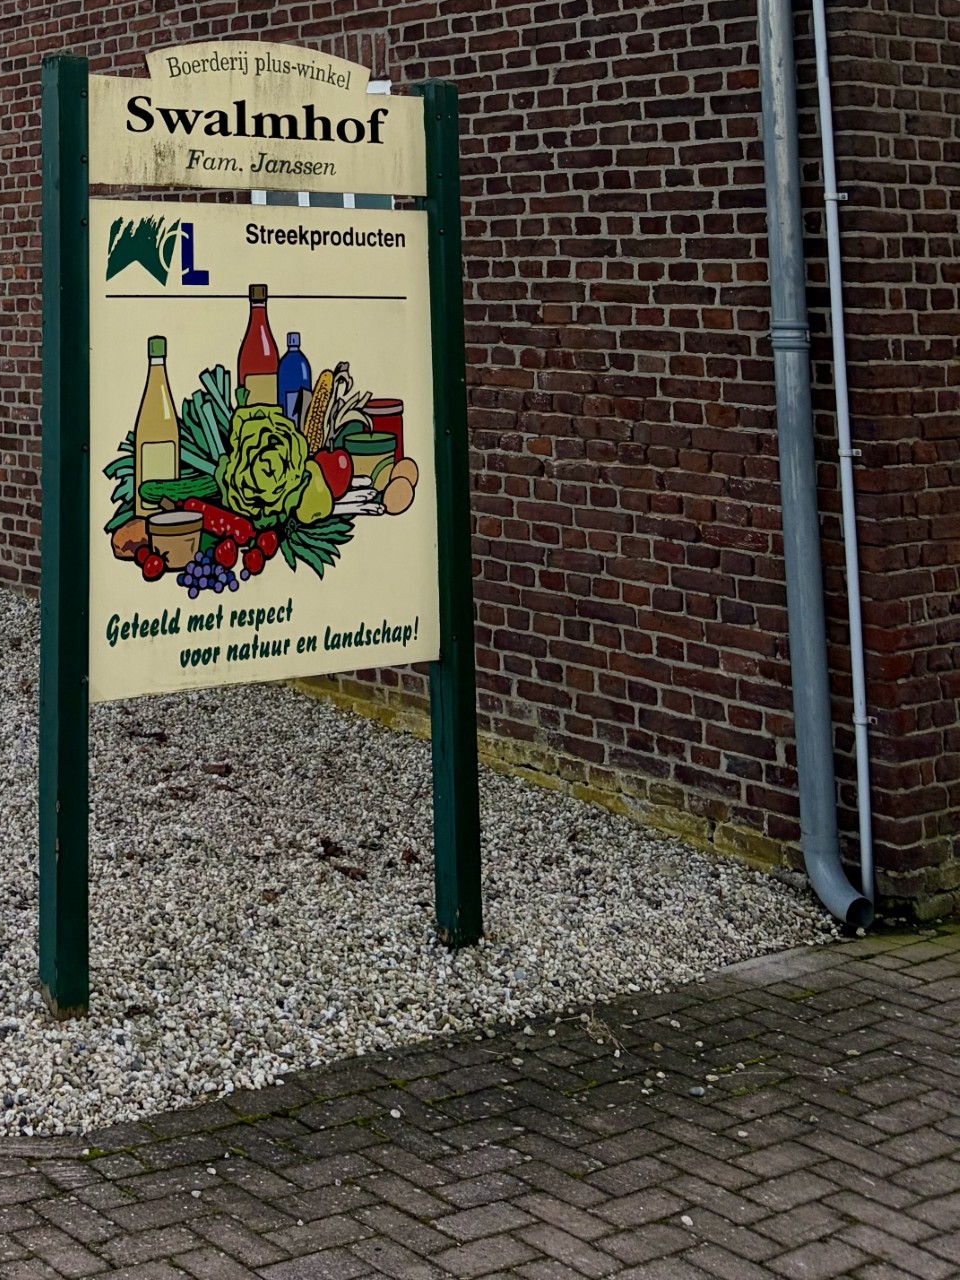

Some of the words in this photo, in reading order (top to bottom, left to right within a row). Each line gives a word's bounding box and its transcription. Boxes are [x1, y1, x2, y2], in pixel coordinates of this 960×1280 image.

[166, 51, 248, 79] Boerderij
[255, 53, 351, 90] plus-winkel
[126, 95, 389, 145] Swalmhof
[186, 148, 244, 172] Fam.
[250, 152, 337, 176] Janssen
[245, 223, 406, 251] Streekproducten
[106, 607, 181, 647] Geteeld
[187, 604, 224, 632] met
[230, 597, 293, 631] respect
[180, 644, 221, 668] voor
[226, 634, 291, 662] natuur
[296, 633, 318, 654] en
[323, 616, 419, 651] landschap!
